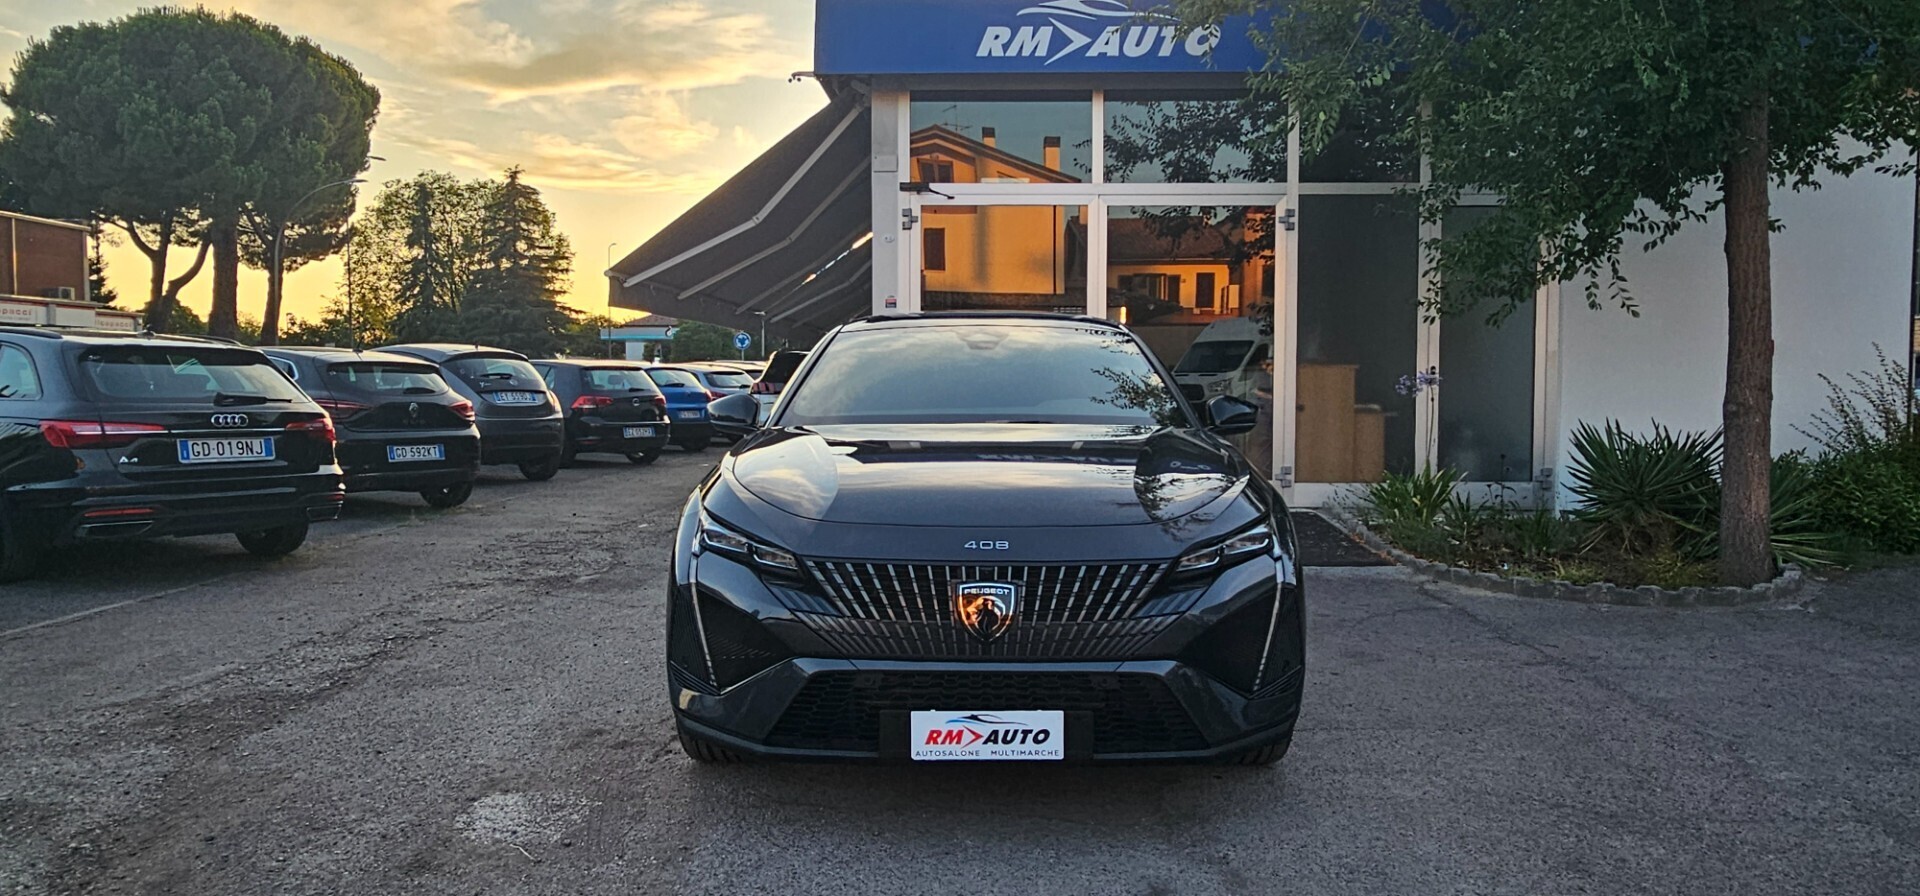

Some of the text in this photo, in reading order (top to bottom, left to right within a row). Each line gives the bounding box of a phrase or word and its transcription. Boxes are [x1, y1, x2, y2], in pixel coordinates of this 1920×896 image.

[975, 24, 1221, 58] RM AUTO
[410, 446, 438, 458] 592KT
[964, 540, 1009, 550] 408
[925, 729, 1050, 745] RM AUTO
[991, 749, 1060, 757] MULTIMARCHE
